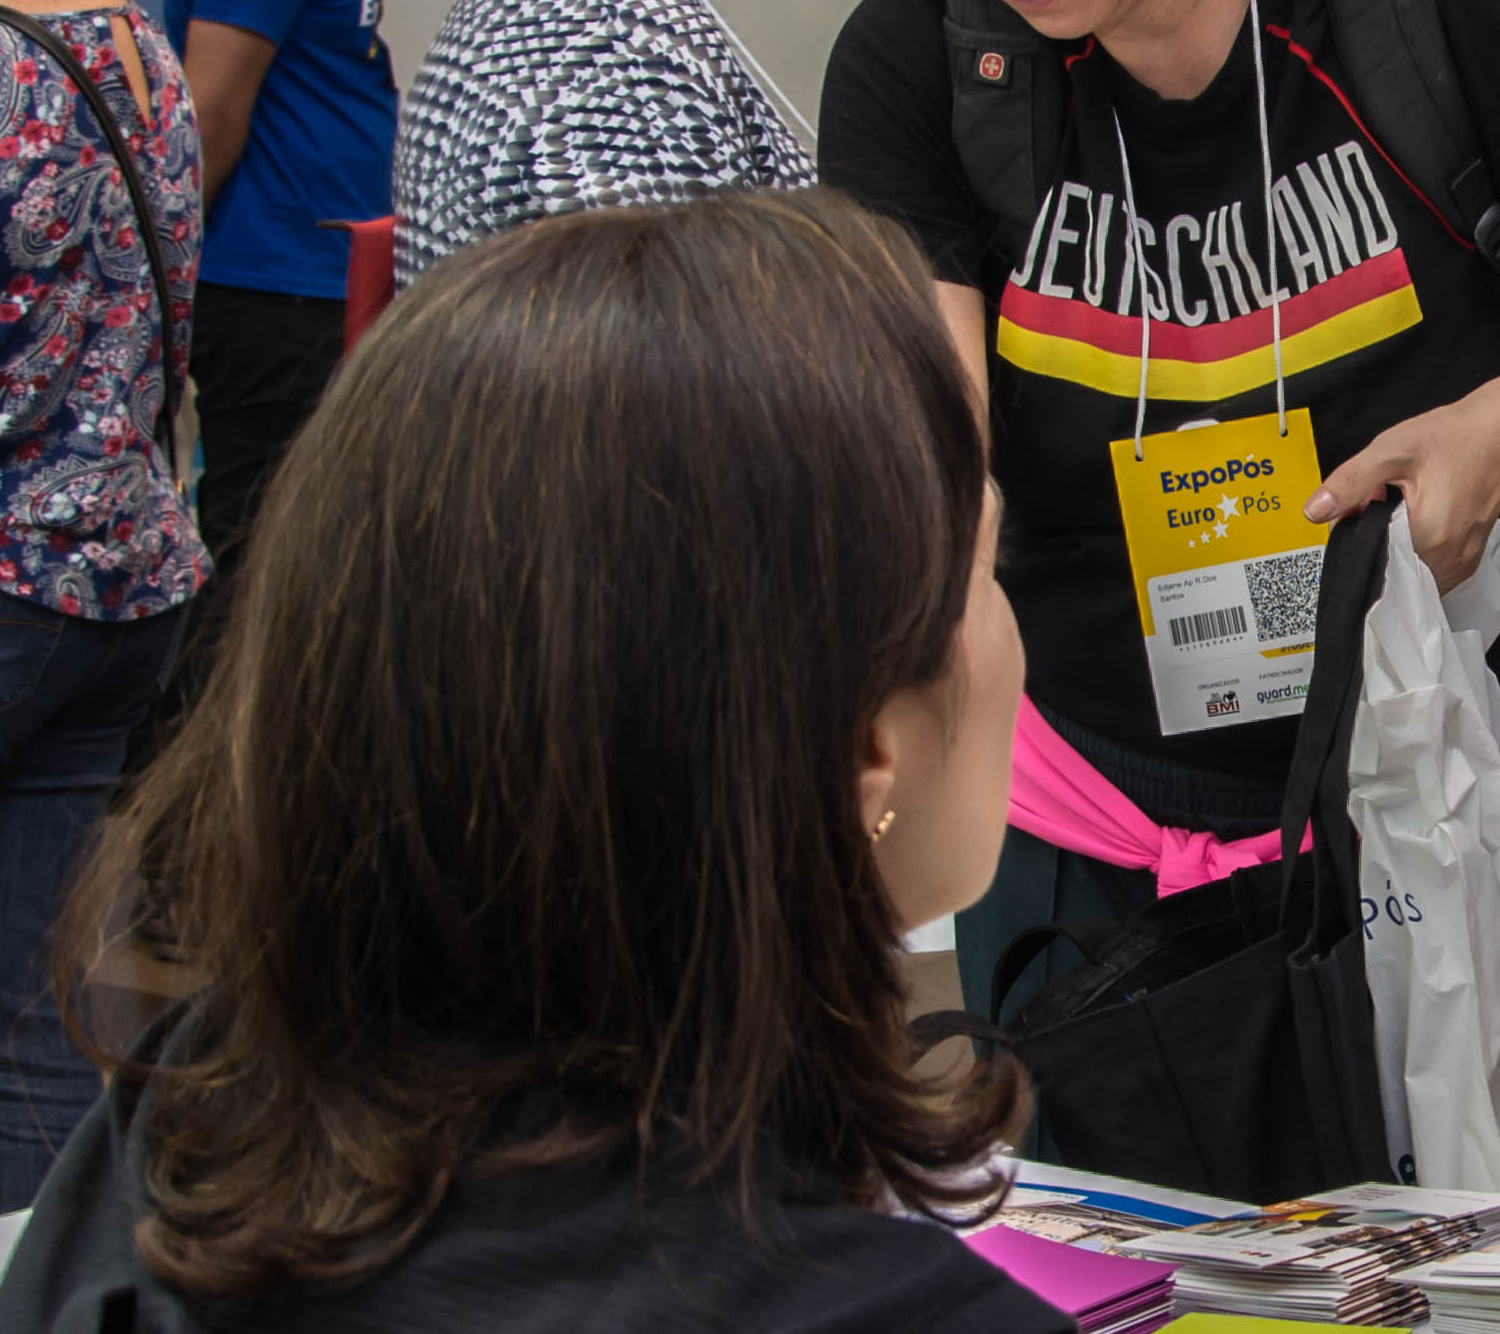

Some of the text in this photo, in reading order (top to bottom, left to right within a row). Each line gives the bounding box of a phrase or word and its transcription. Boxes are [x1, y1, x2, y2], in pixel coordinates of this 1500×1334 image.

[1160, 454, 1275, 494] ExpoPós
[1166, 491, 1282, 529] Euro Pós
[1206, 700, 1240, 715] BMI
